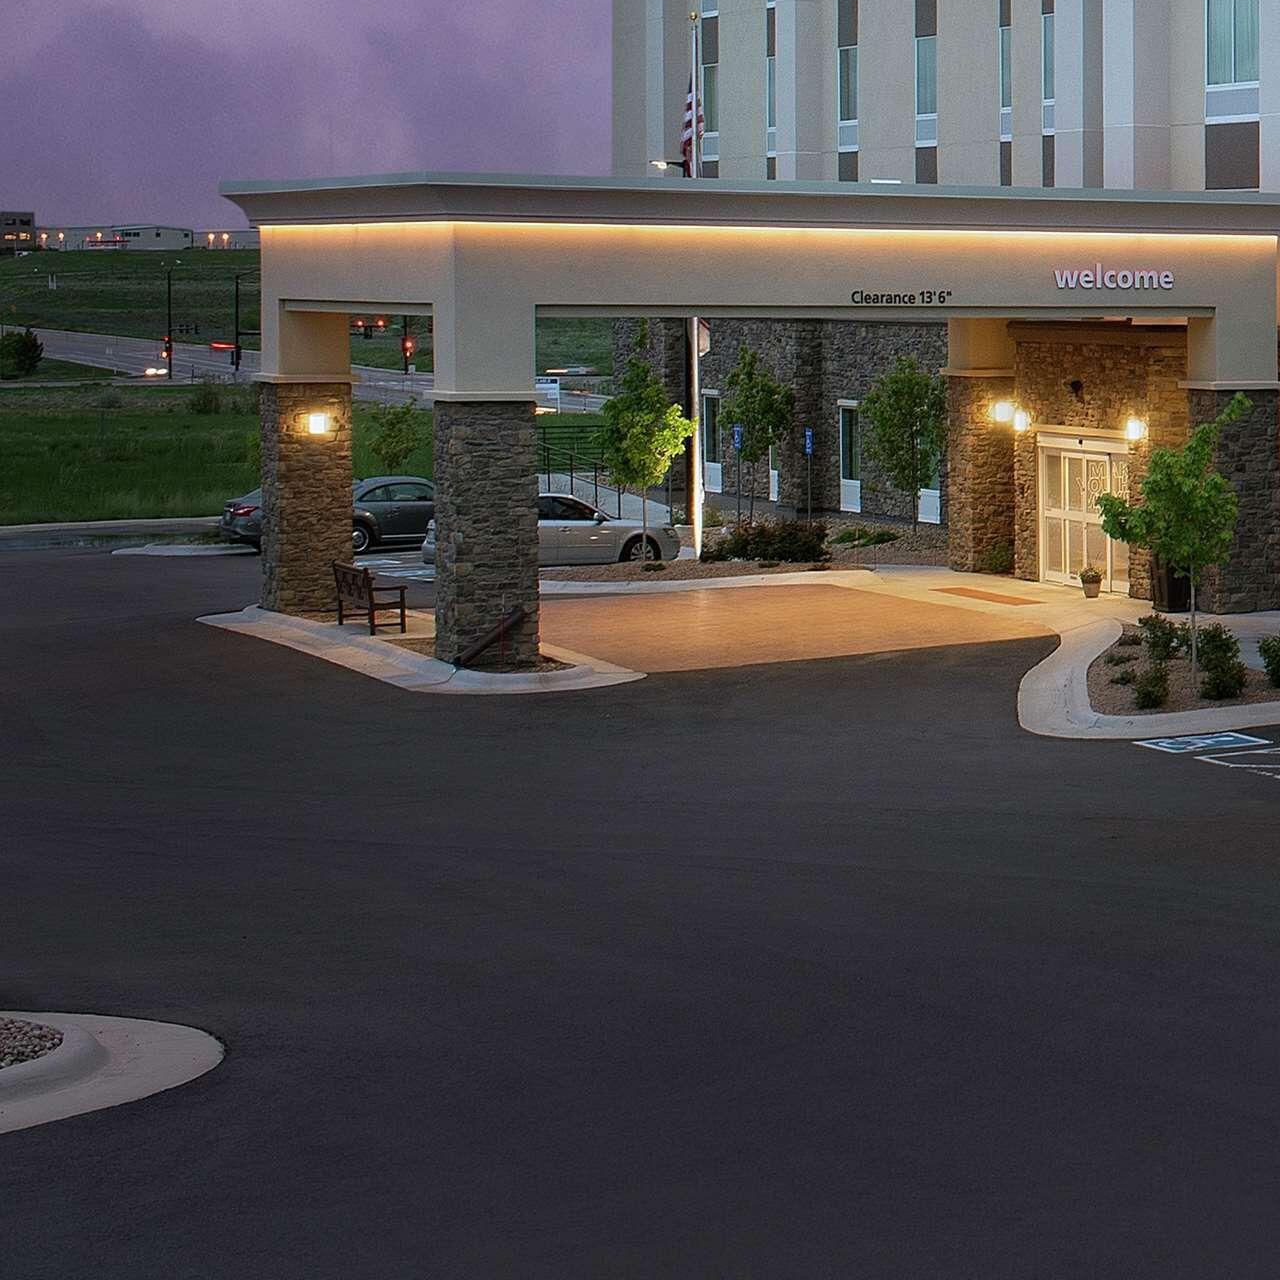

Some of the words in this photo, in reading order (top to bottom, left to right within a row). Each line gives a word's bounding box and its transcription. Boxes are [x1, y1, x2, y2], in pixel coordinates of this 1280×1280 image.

[1054, 263, 1175, 289] welcome
[851, 290, 916, 304] Clearance
[919, 290, 952, 304] 13'6"
